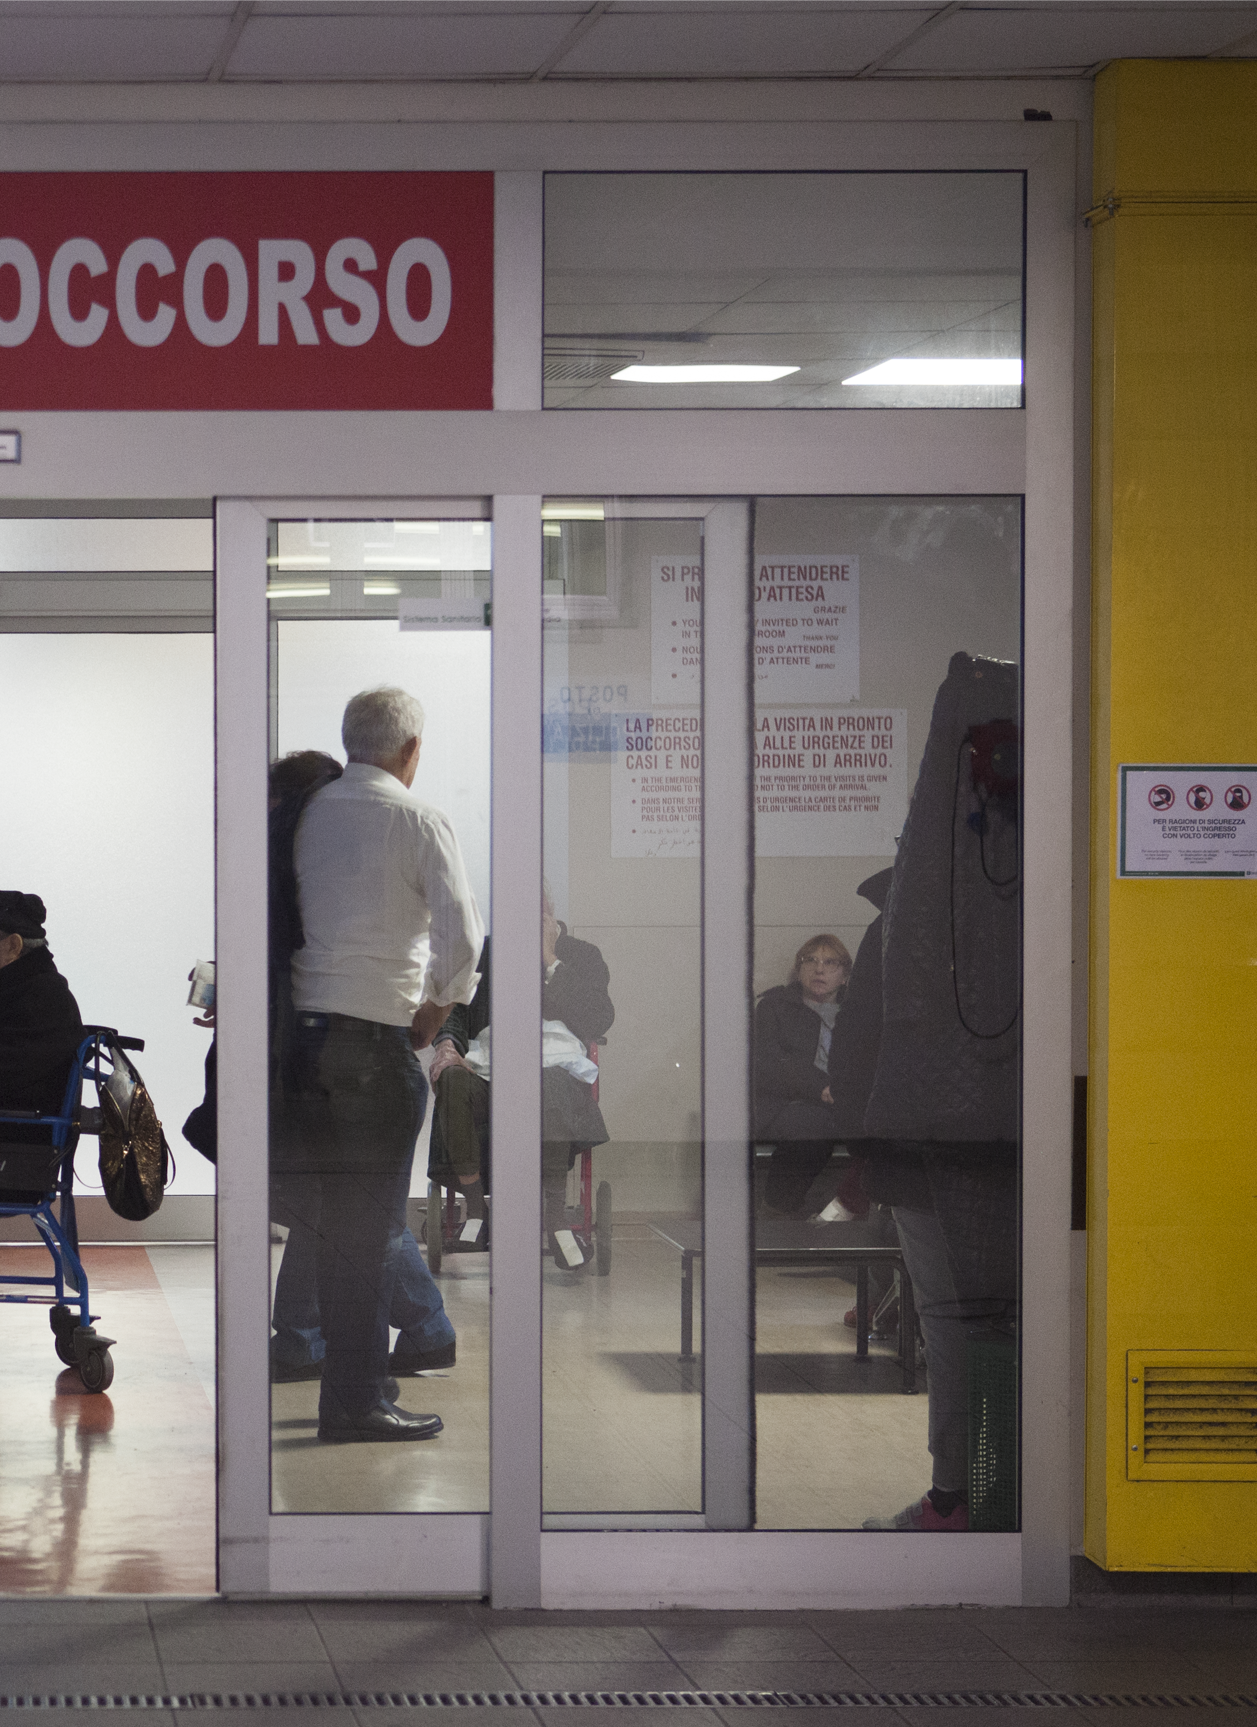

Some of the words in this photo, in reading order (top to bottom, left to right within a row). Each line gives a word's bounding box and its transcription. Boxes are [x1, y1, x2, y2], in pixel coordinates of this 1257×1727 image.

[660, 565, 676, 583] SI
[759, 564, 851, 582] ATTENDERE
[685, 585, 701, 603] IN
[754, 585, 826, 602] D'ATTESA
[813, 605, 848, 615] GRAZIE
[402, 614, 439, 623] Sistema
[681, 618, 701, 628] YOU
[761, 618, 798, 627] INVITED
[801, 618, 813, 627] TO
[816, 617, 839, 627] WAIT
[681, 630, 691, 639] IN
[681, 645, 701, 655] NOU
[777, 645, 836, 654] D'ATTENDRE
[681, 656, 701, 666] DAN
[769, 656, 811, 665] ATTENTE
[625, 718, 642, 733] LA
[646, 717, 701, 733] PRECED
[774, 716, 816, 732] VISITA
[820, 716, 834, 732] IN
[838, 715, 893, 732] PRONTO
[625, 735, 701, 752] SOCCORSO
[763, 735, 797, 751] ALLE
[802, 734, 866, 750] URGENZE
[871, 734, 893, 750] DEI
[625, 754, 658, 770] CASI
[665, 754, 673, 770] E
[680, 754, 700, 770] NO
[812, 753, 827, 769] DI
[833, 752, 893, 769] ARRIVO.
[774, 775, 806, 783] PRIORITY
